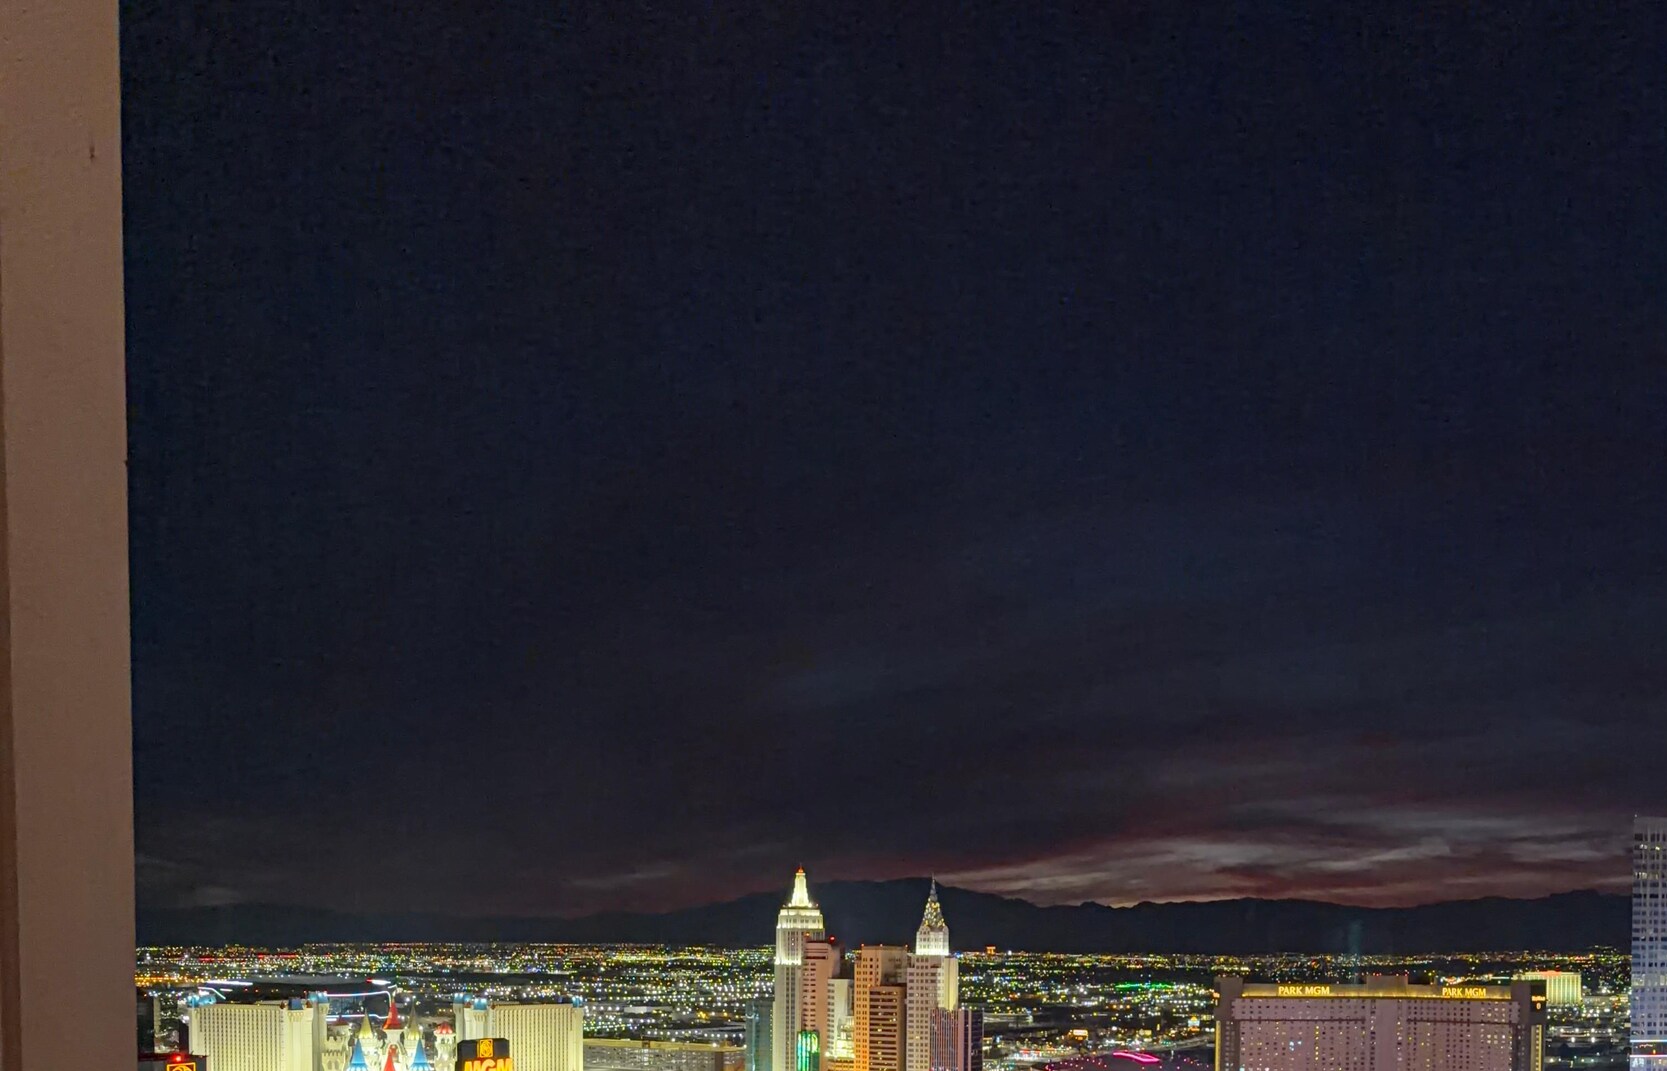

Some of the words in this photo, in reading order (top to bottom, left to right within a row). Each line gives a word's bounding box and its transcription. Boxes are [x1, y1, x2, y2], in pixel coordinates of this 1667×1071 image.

[1278, 985, 1303, 996] PARK
[1304, 985, 1331, 996] MGM
[1441, 987, 1463, 997] PARK
[1464, 987, 1487, 997] MGM
